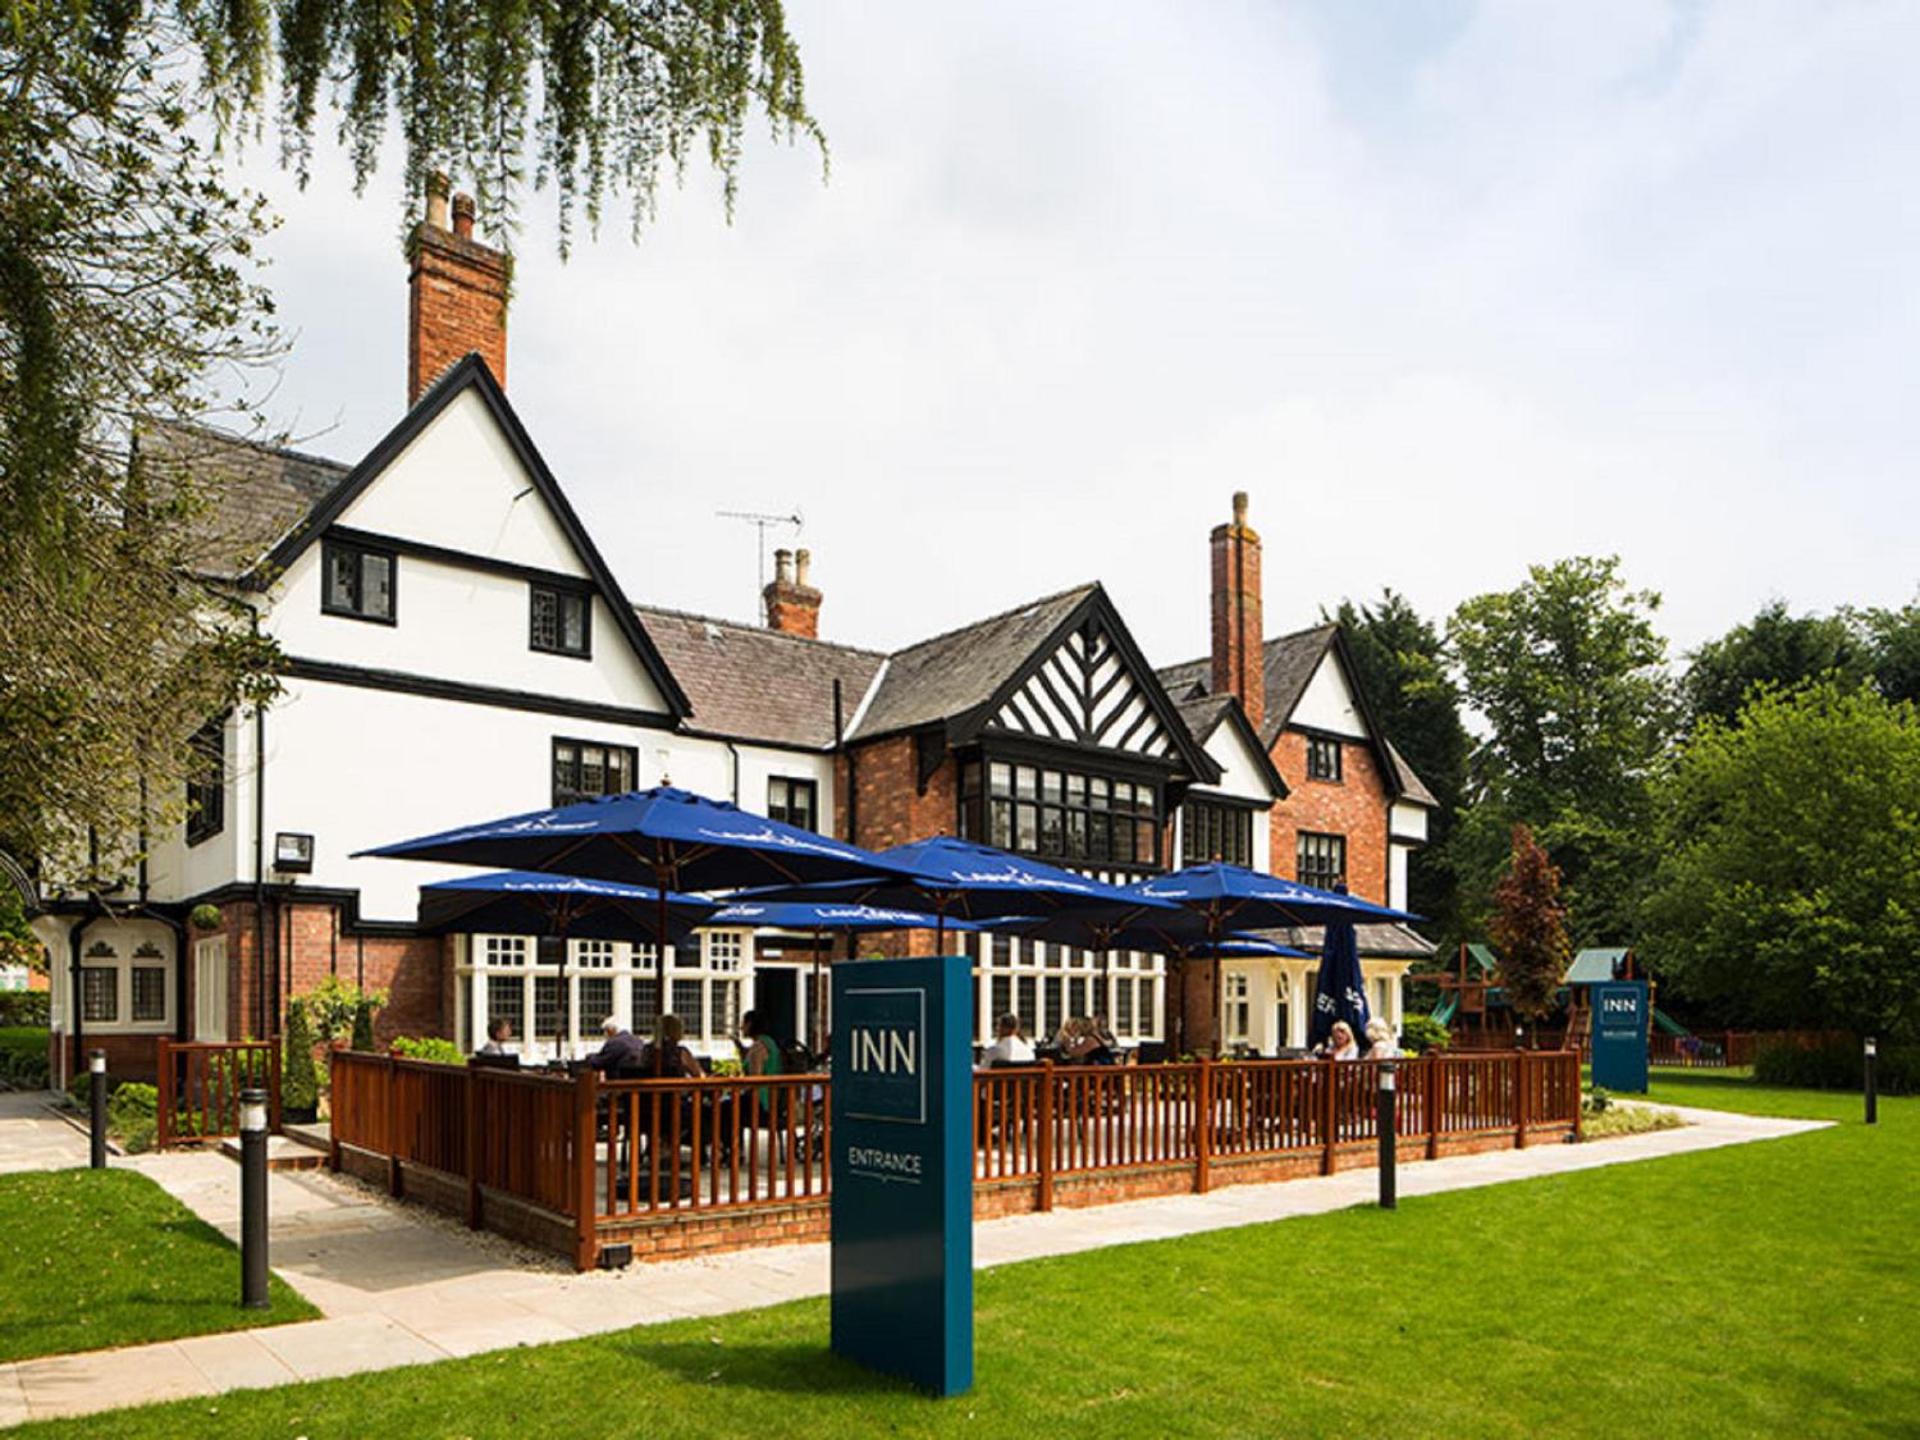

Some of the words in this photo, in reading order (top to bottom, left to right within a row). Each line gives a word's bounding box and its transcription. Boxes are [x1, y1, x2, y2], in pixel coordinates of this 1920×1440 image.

[1604, 998, 1637, 1012] INN
[851, 1028, 916, 1075] INN
[848, 1146, 922, 1174] ENTRANCE
